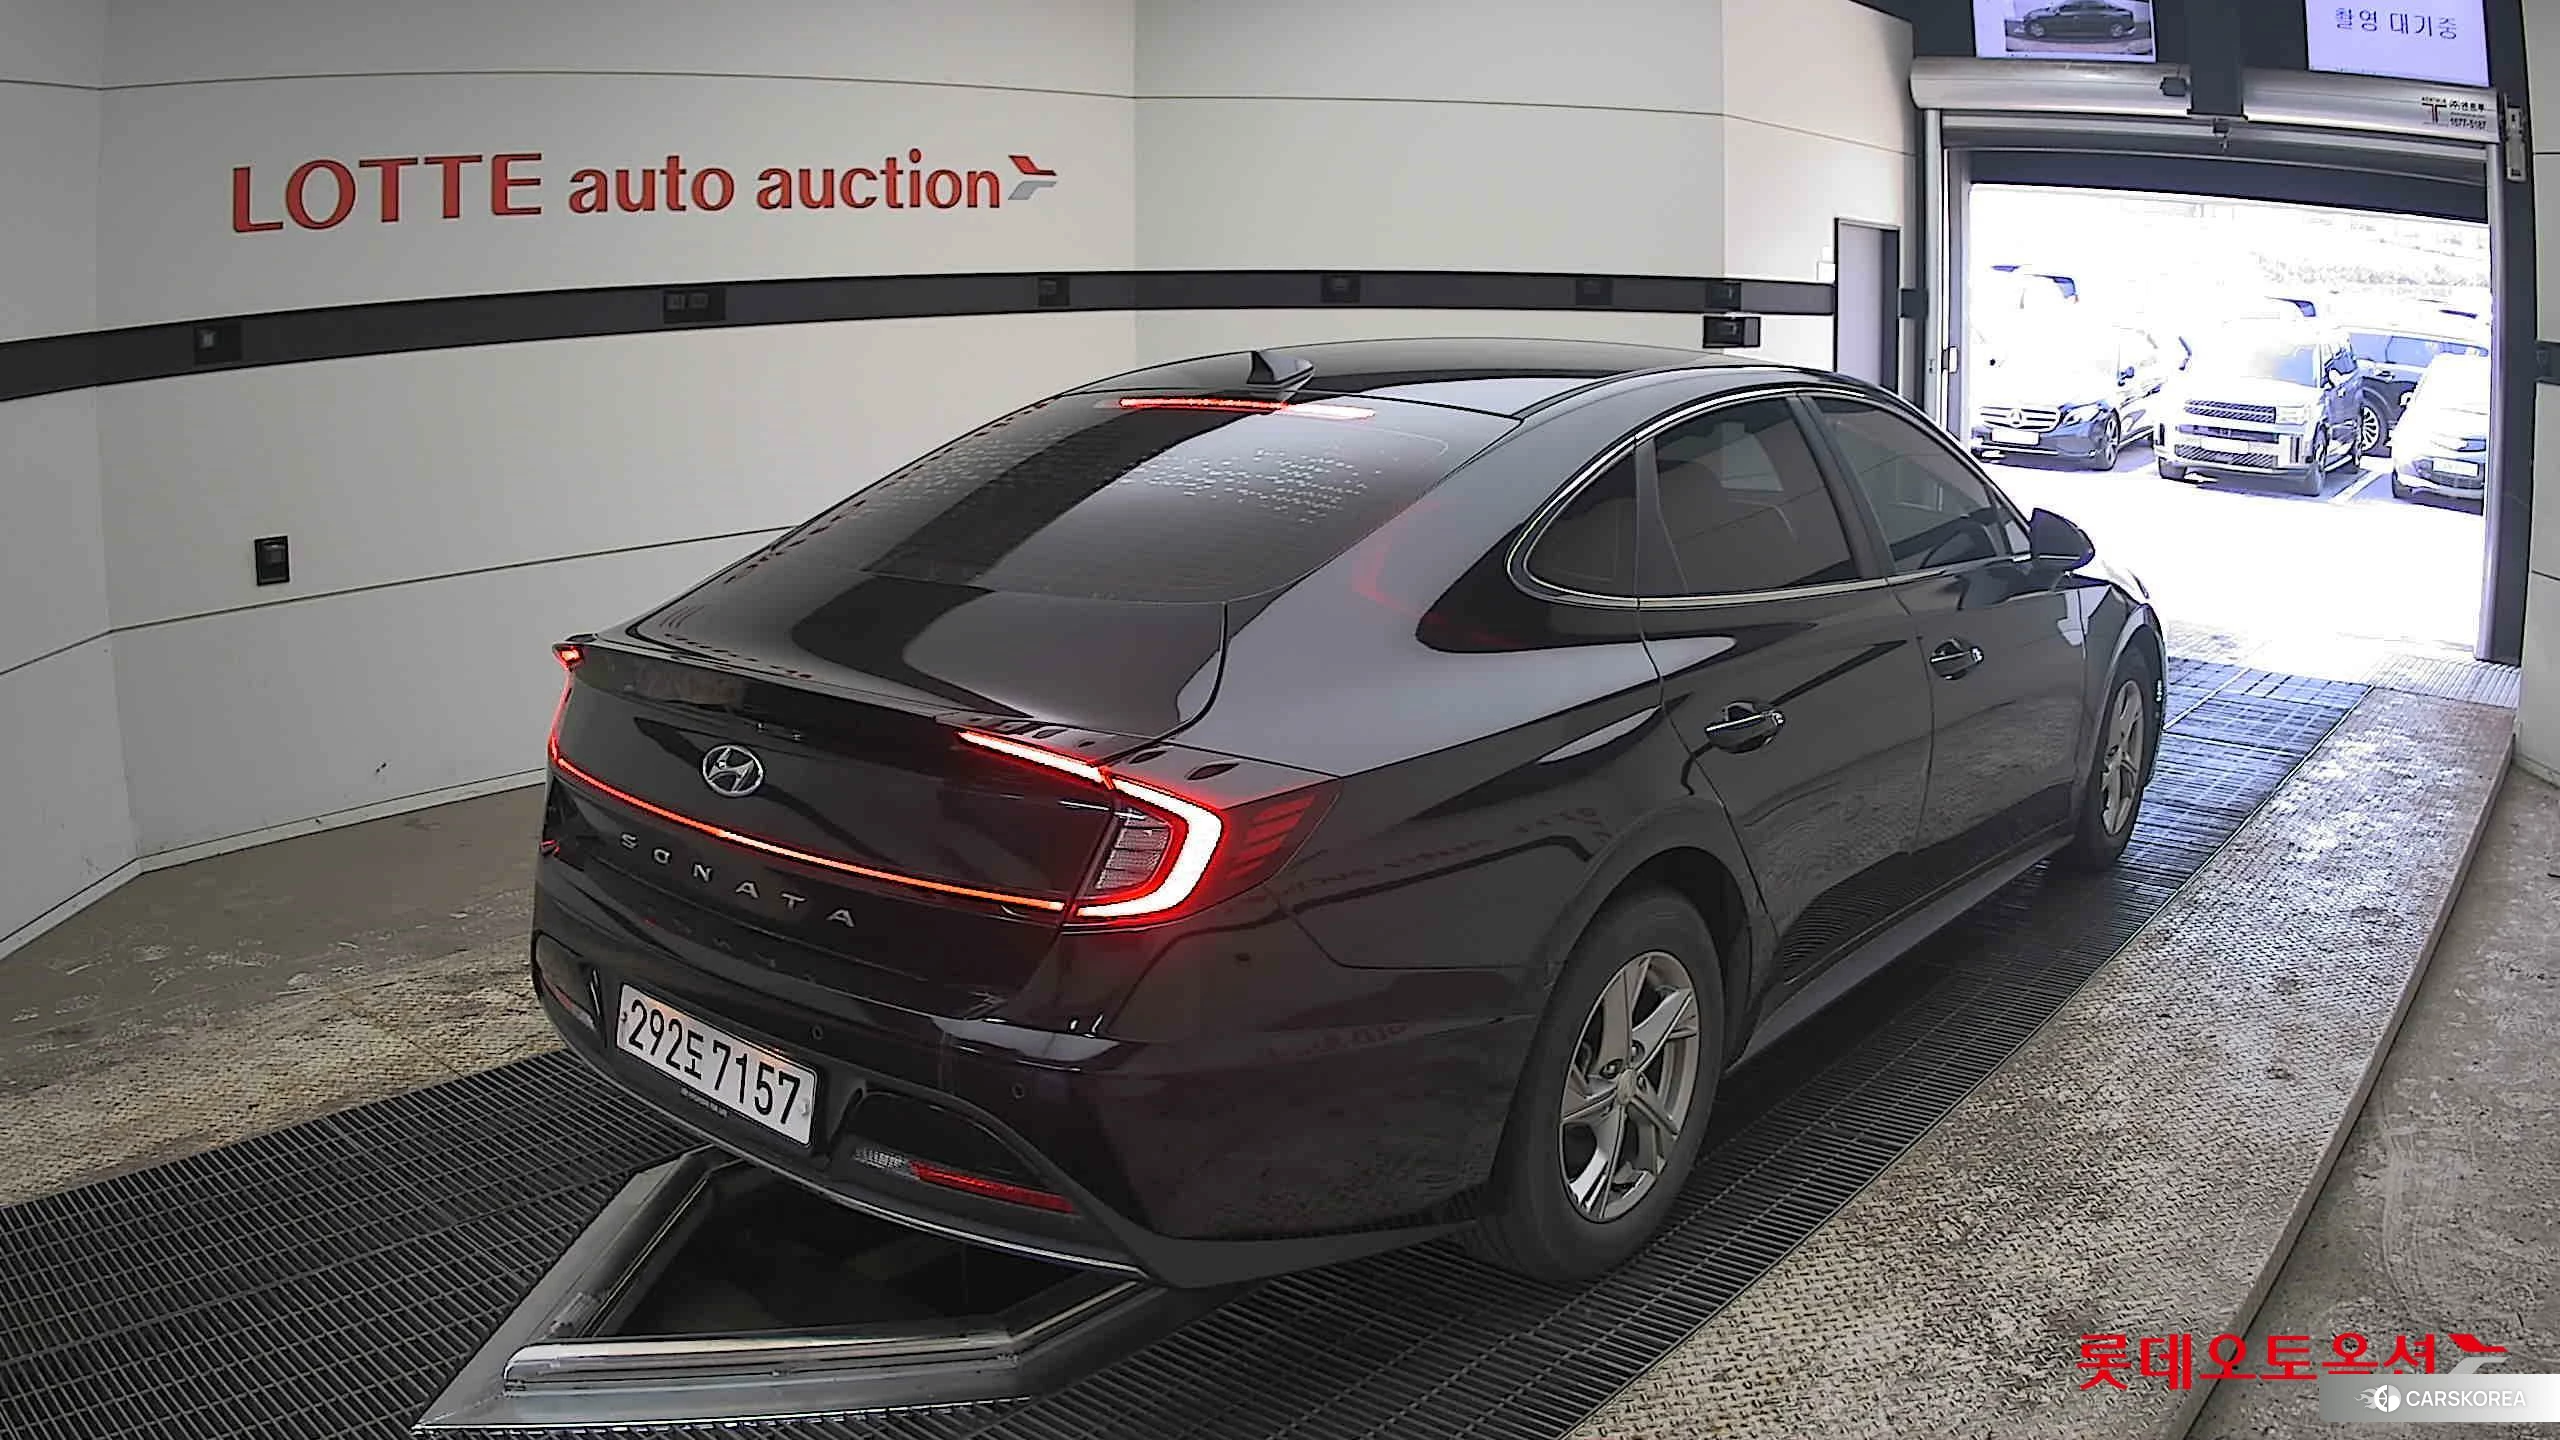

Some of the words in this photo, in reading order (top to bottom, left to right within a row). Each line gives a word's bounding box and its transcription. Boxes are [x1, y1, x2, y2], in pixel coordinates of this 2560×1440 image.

[232, 153, 542, 233] LOTTE
[568, 154, 735, 213] auto
[756, 147, 1000, 209] auction
[620, 832, 855, 928] SONATA
